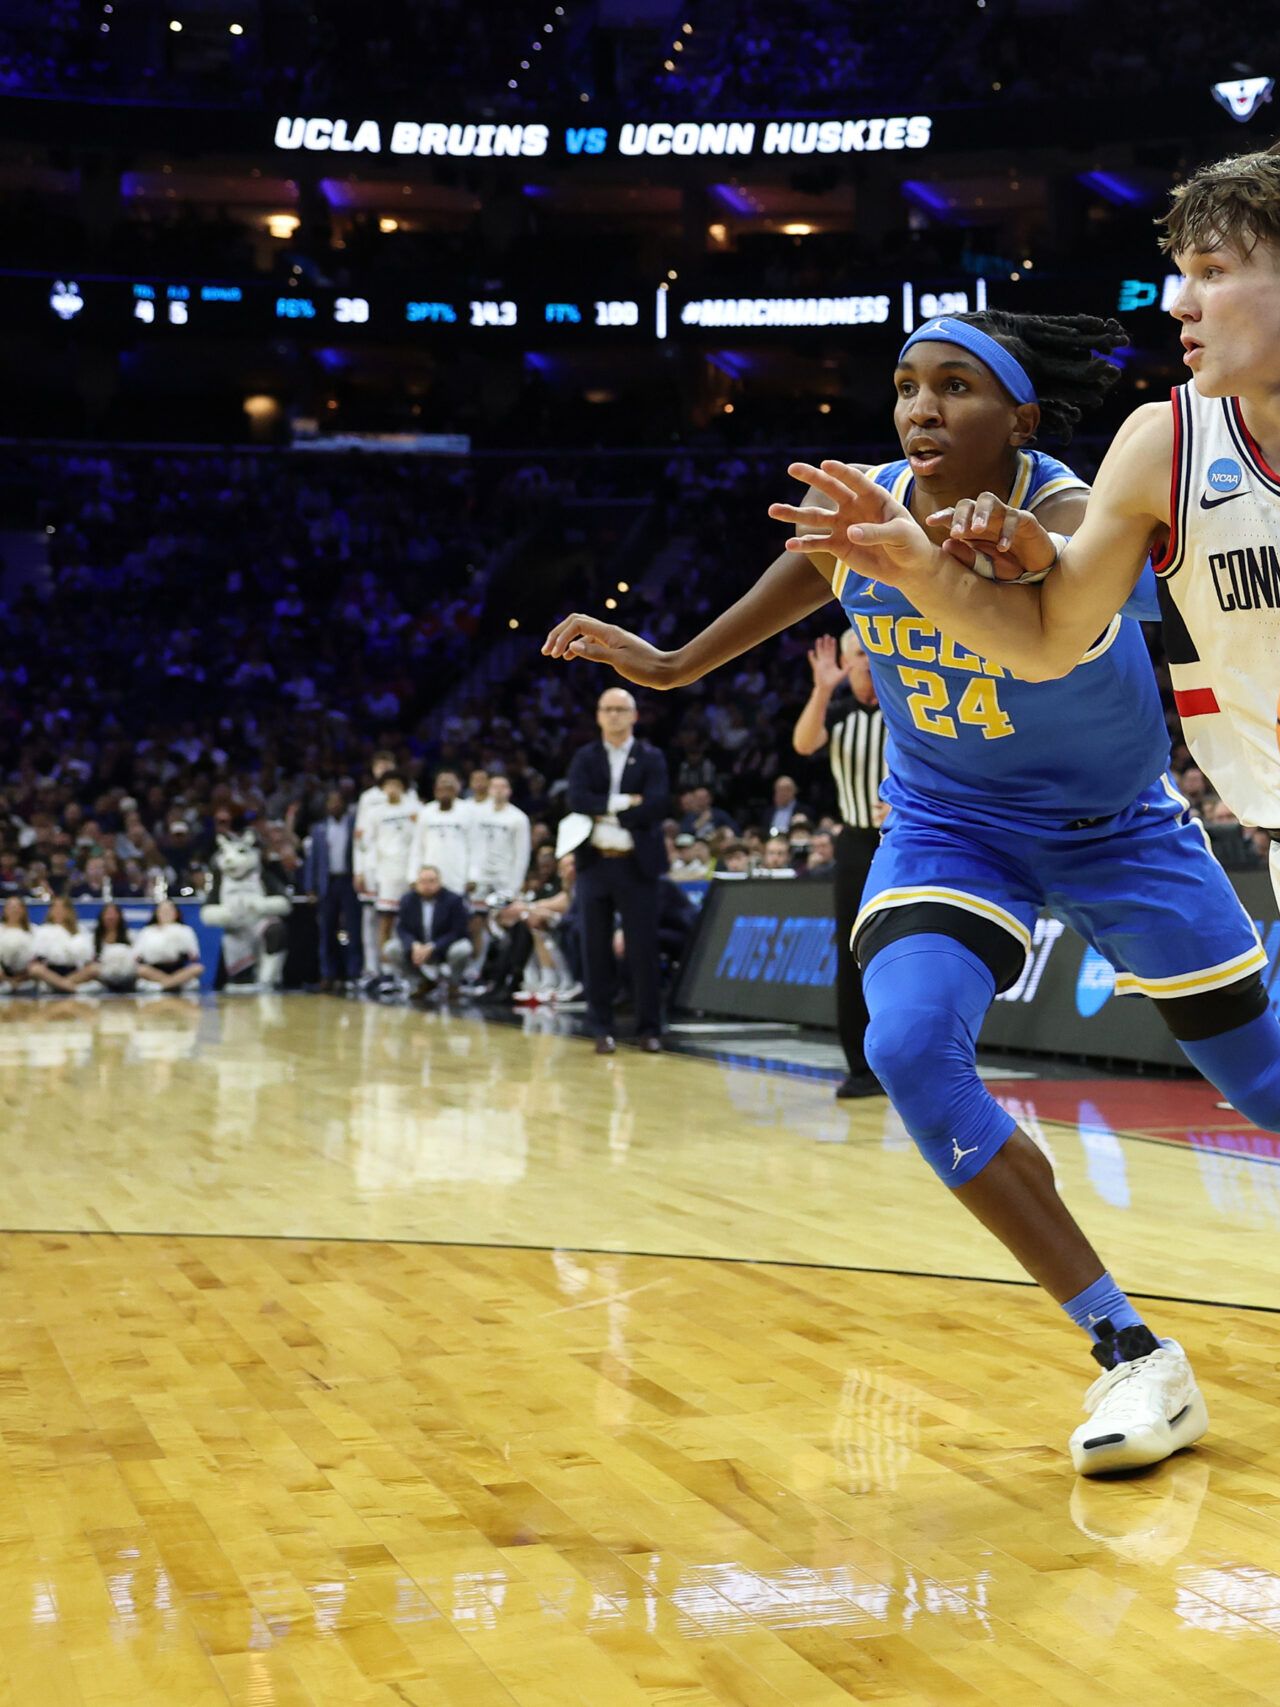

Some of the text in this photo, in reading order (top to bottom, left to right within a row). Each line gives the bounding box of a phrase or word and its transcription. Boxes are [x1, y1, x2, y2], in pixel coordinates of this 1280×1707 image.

[275, 116, 932, 156] UCLA BRUINS VS UCONN HUSKIES
[680, 294, 891, 328] #MARCHMADNESS
[1211, 473, 1239, 484] NCAA
[897, 665, 1016, 741] 24
